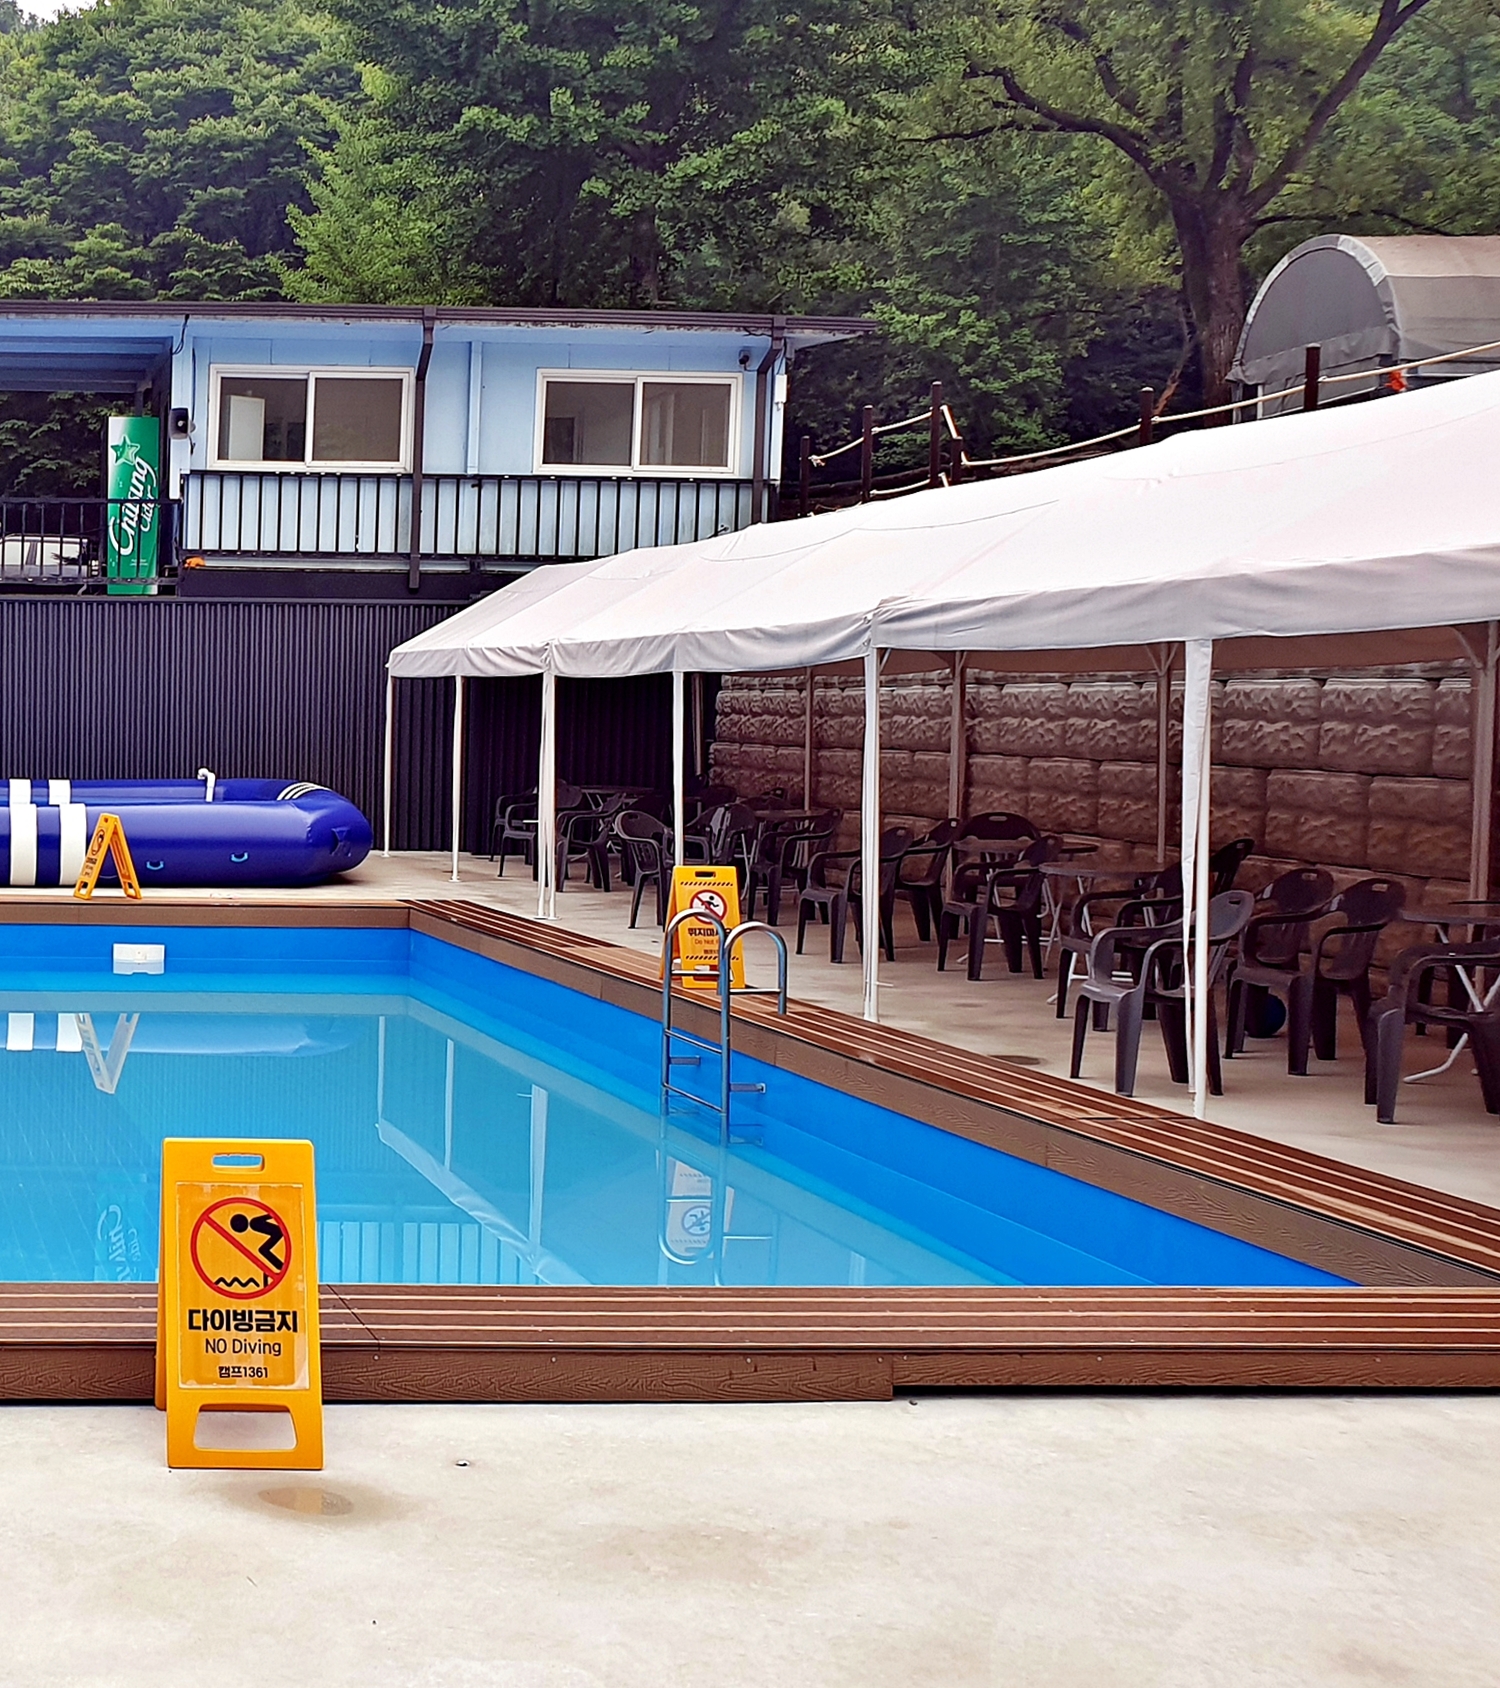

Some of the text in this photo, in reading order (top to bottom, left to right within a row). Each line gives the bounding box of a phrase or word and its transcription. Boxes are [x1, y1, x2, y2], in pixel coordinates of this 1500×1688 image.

[188, 1309, 298, 1332] 다이빙금지
[205, 1338, 282, 1356] NO Diving
[218, 1366, 268, 1378] 캠프1361
